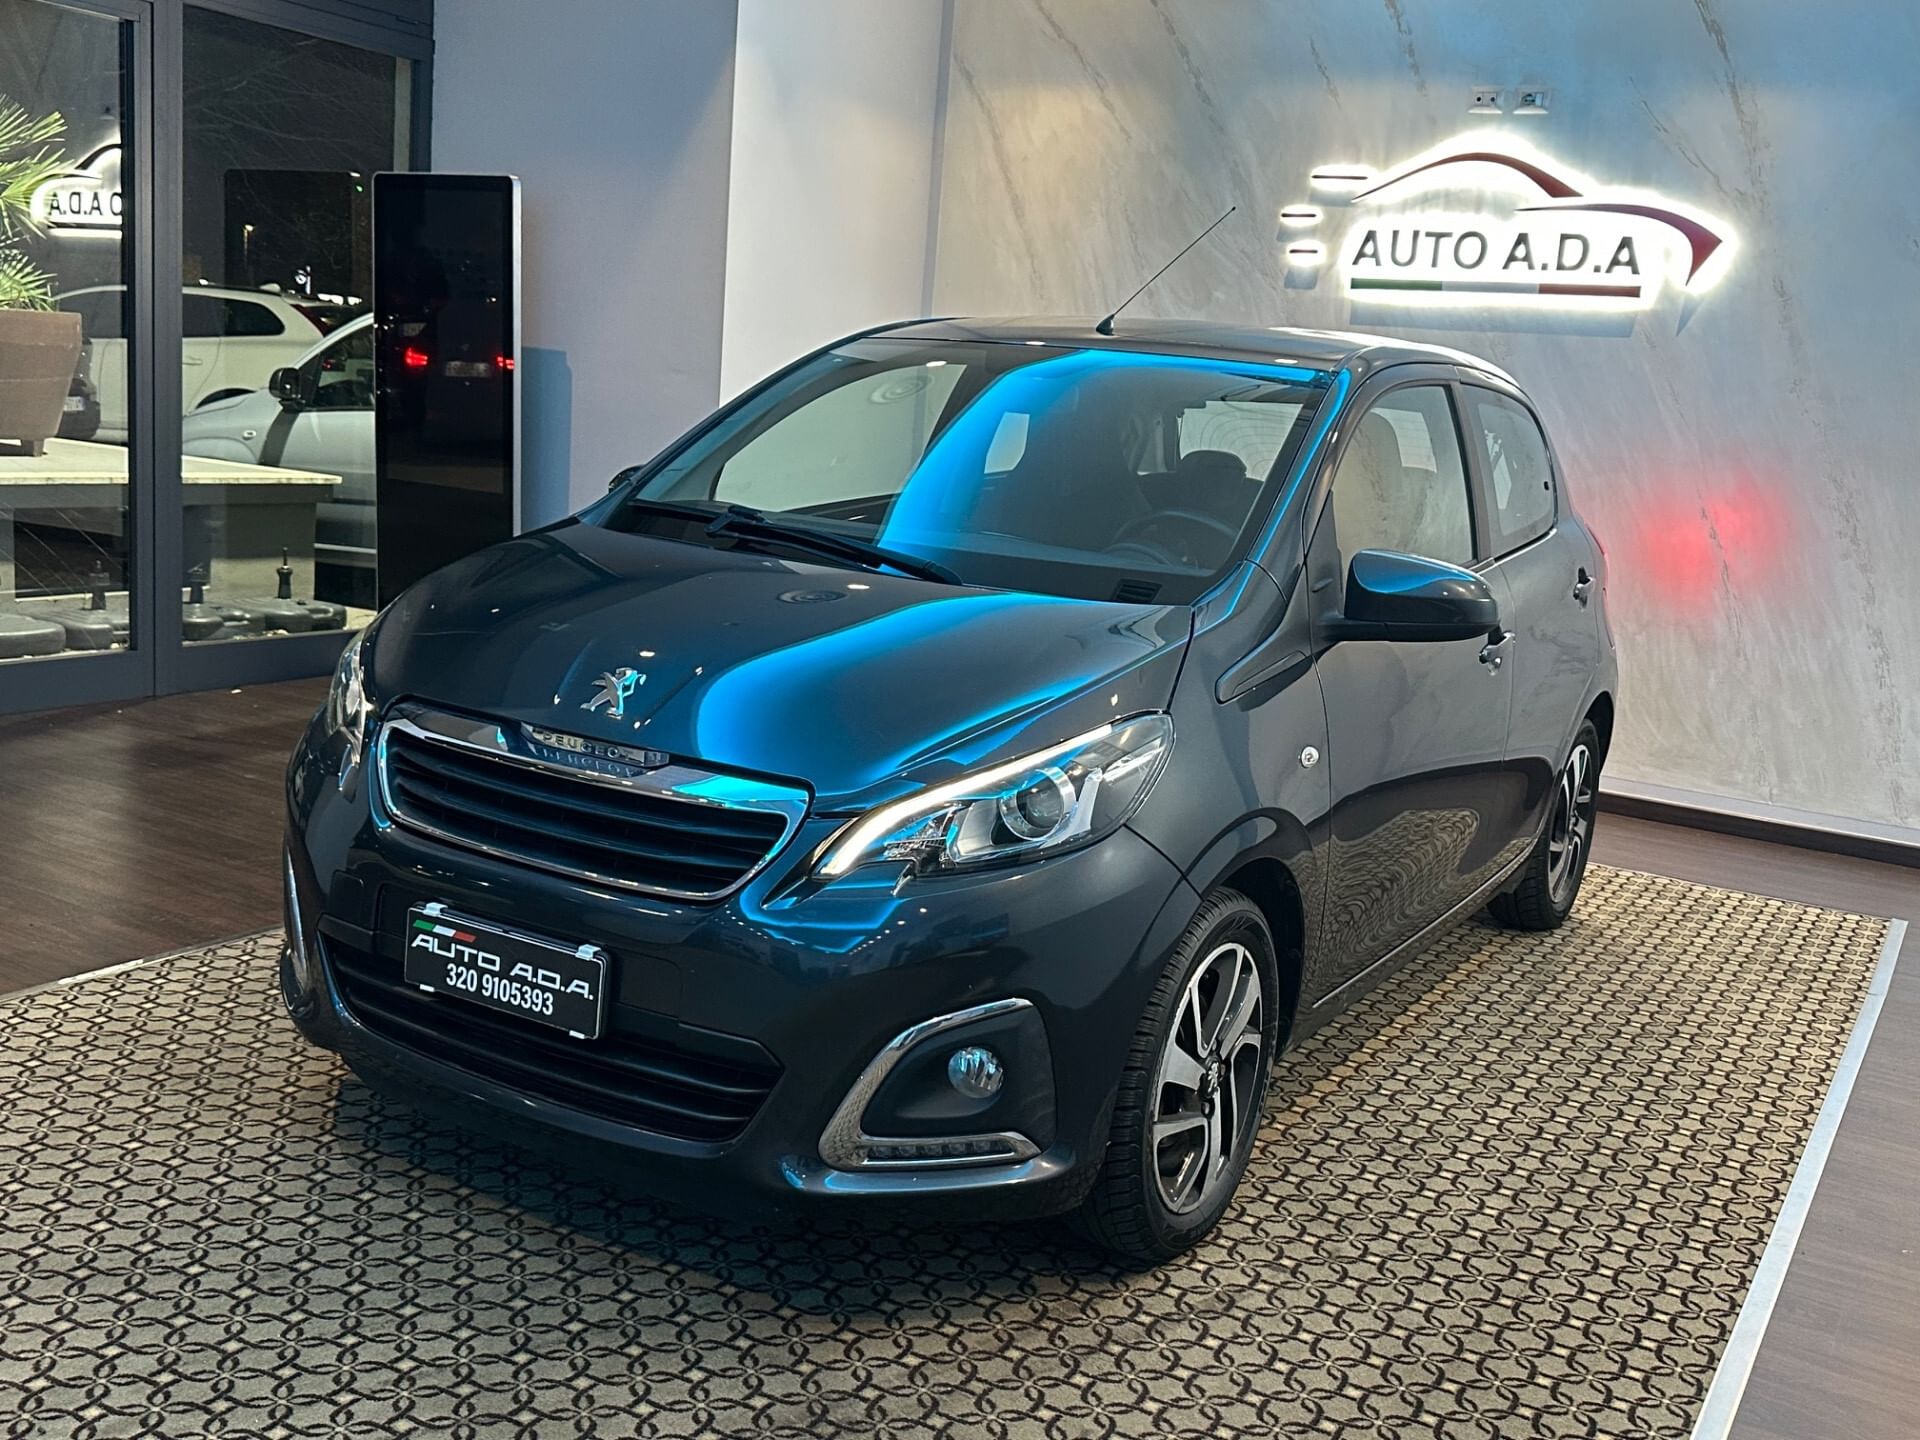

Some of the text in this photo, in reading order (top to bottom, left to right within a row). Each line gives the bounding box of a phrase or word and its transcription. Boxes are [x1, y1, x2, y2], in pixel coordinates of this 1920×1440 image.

[1352, 230, 1640, 275] AUTO A.D.A
[412, 934, 594, 1000] AUTO A.D.A.
[446, 963, 554, 1015] 320 9105393
